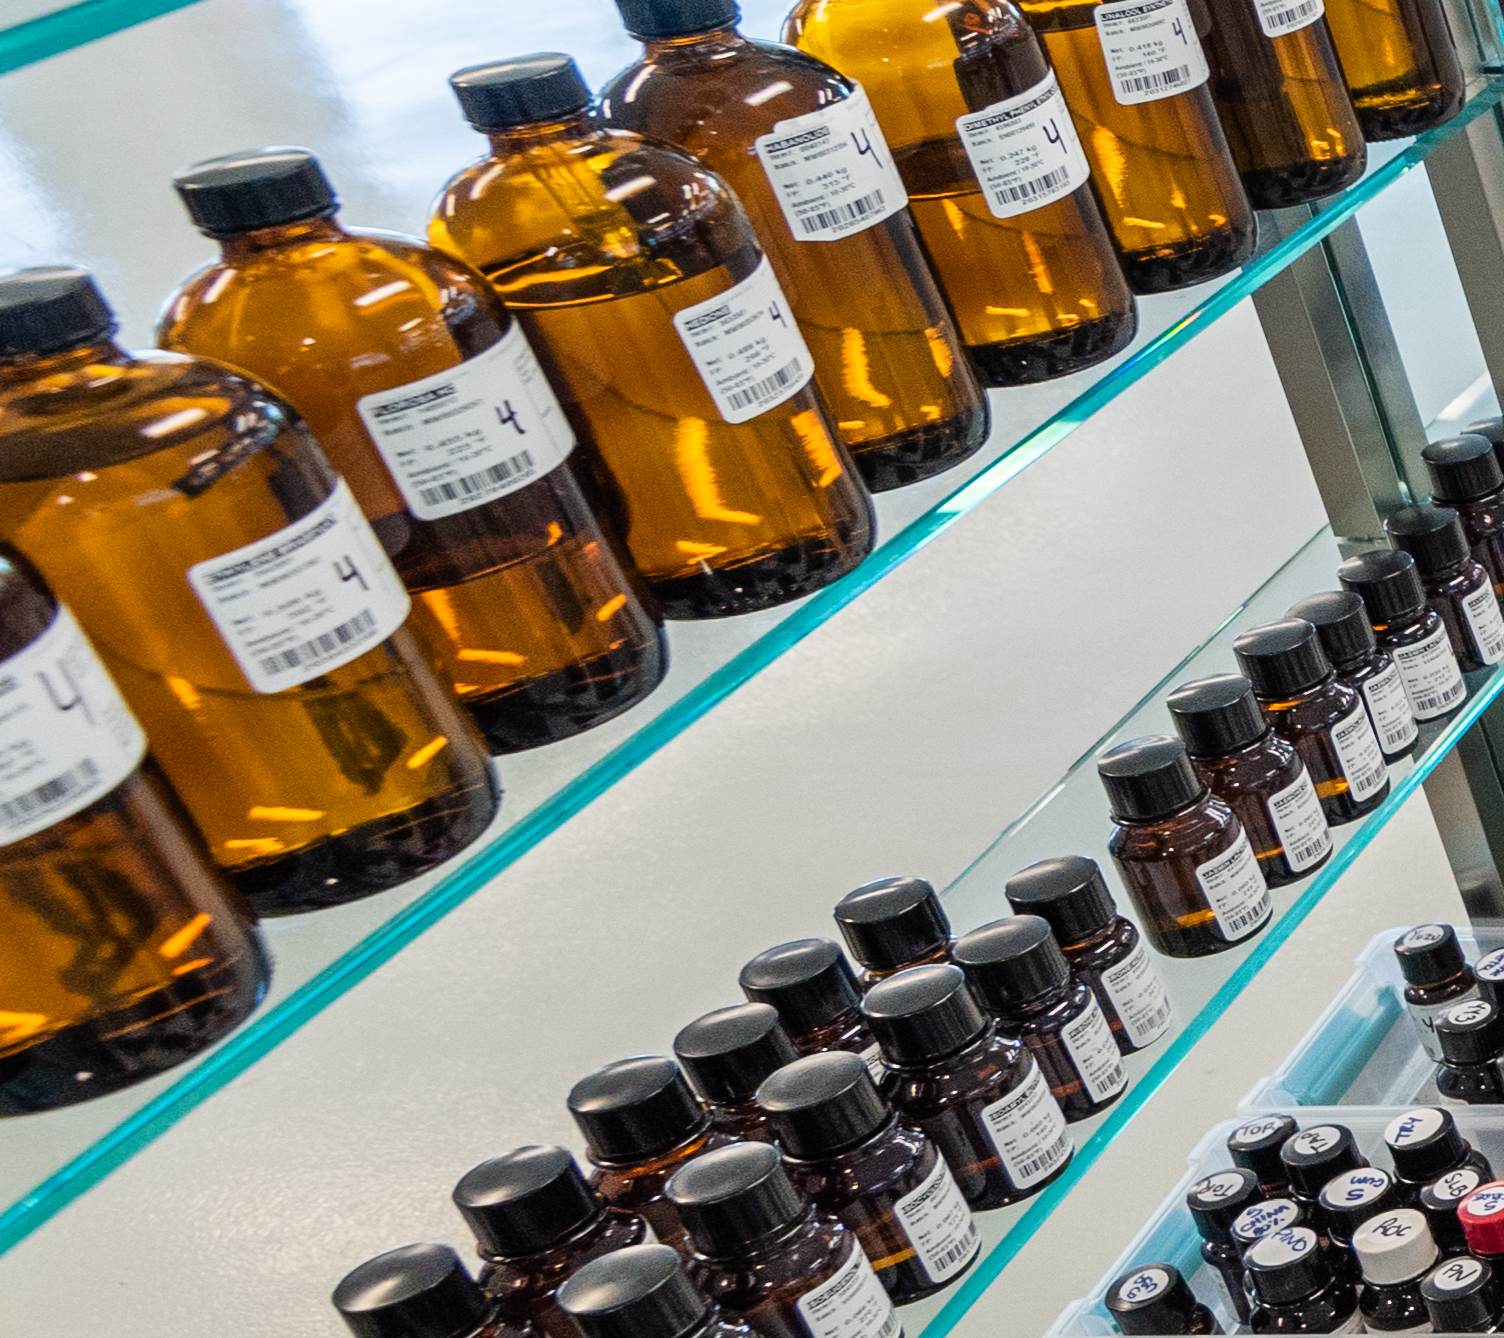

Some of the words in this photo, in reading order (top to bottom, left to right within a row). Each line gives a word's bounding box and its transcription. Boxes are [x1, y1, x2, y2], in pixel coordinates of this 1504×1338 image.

[1172, 17, 1187, 45] 4
[851, 128, 883, 169] 4
[1043, 118, 1067, 154] 4
[769, 300, 787, 328] 4
[495, 399, 526, 435] 4
[333, 555, 370, 591] 4
[36, 661, 96, 727] 4
